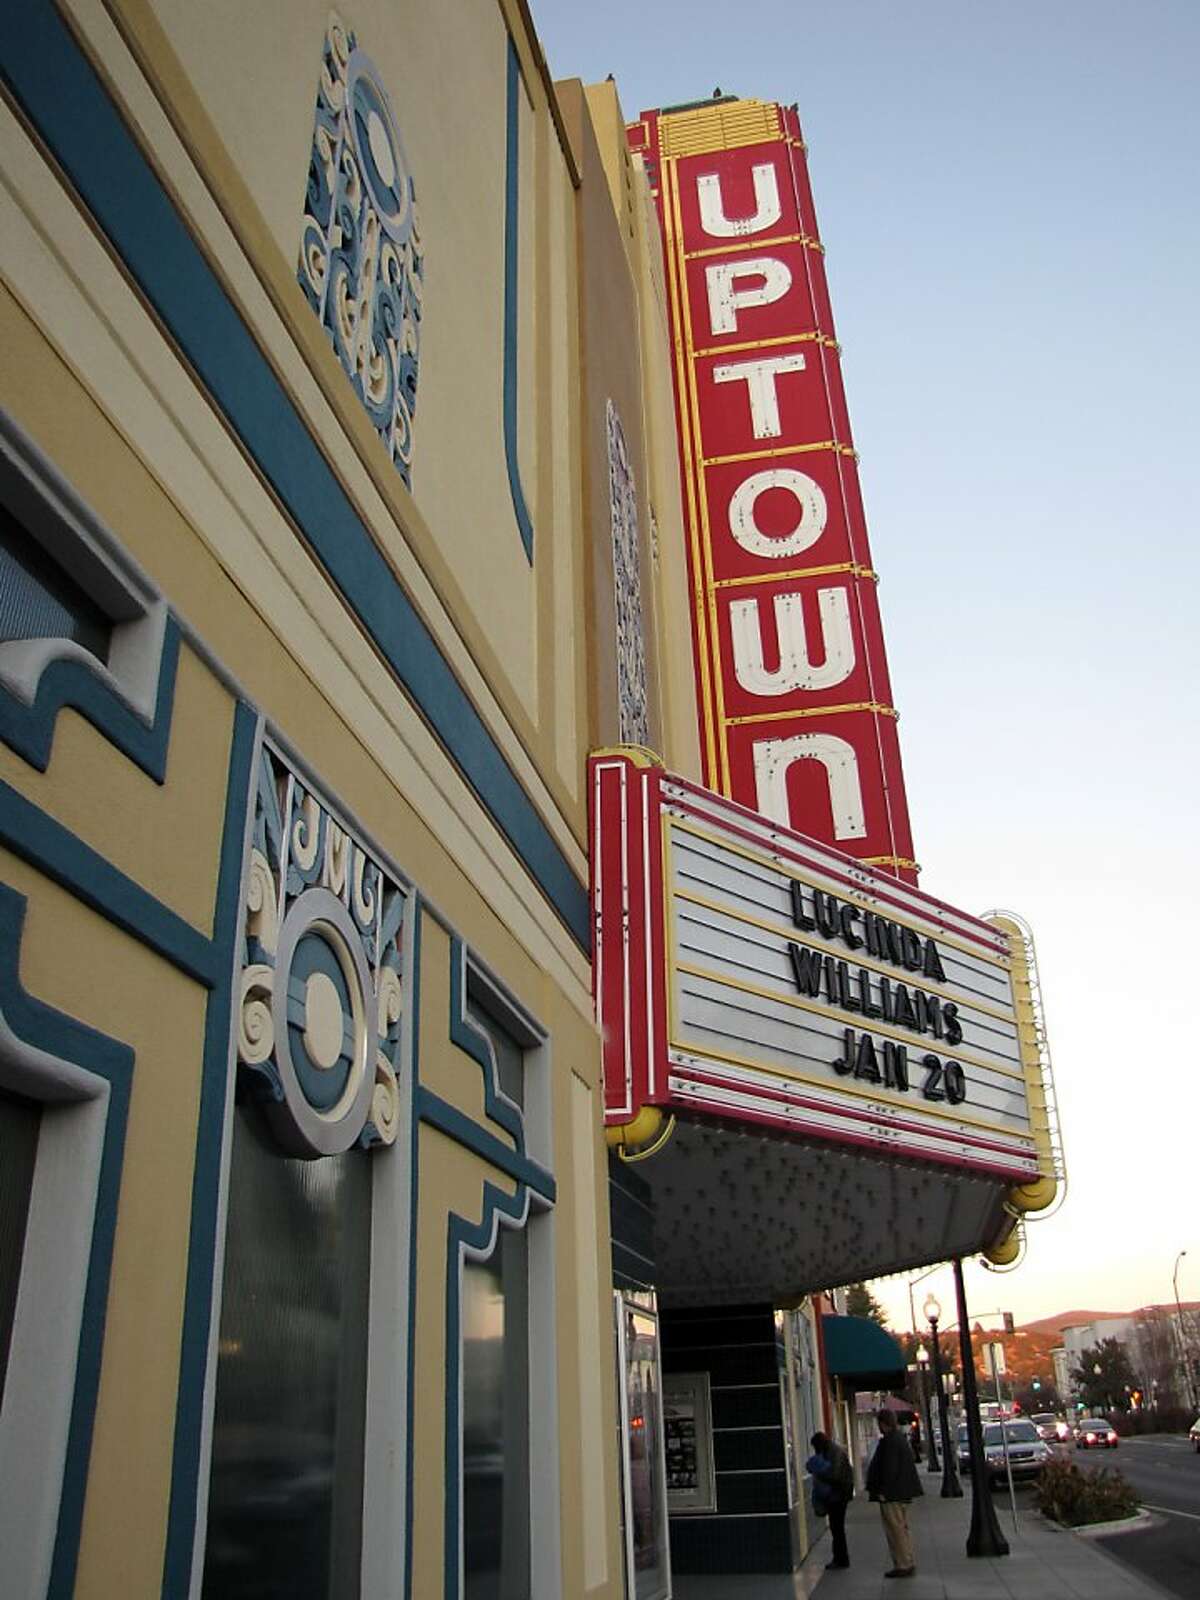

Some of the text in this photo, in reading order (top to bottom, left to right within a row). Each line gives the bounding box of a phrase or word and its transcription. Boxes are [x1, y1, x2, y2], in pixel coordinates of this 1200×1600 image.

[697, 163, 867, 840] UPTOWN
[790, 879, 948, 983] LUCINDA
[788, 942, 963, 1046] WILLIAMS
[833, 1028, 966, 1105] JAN 20
